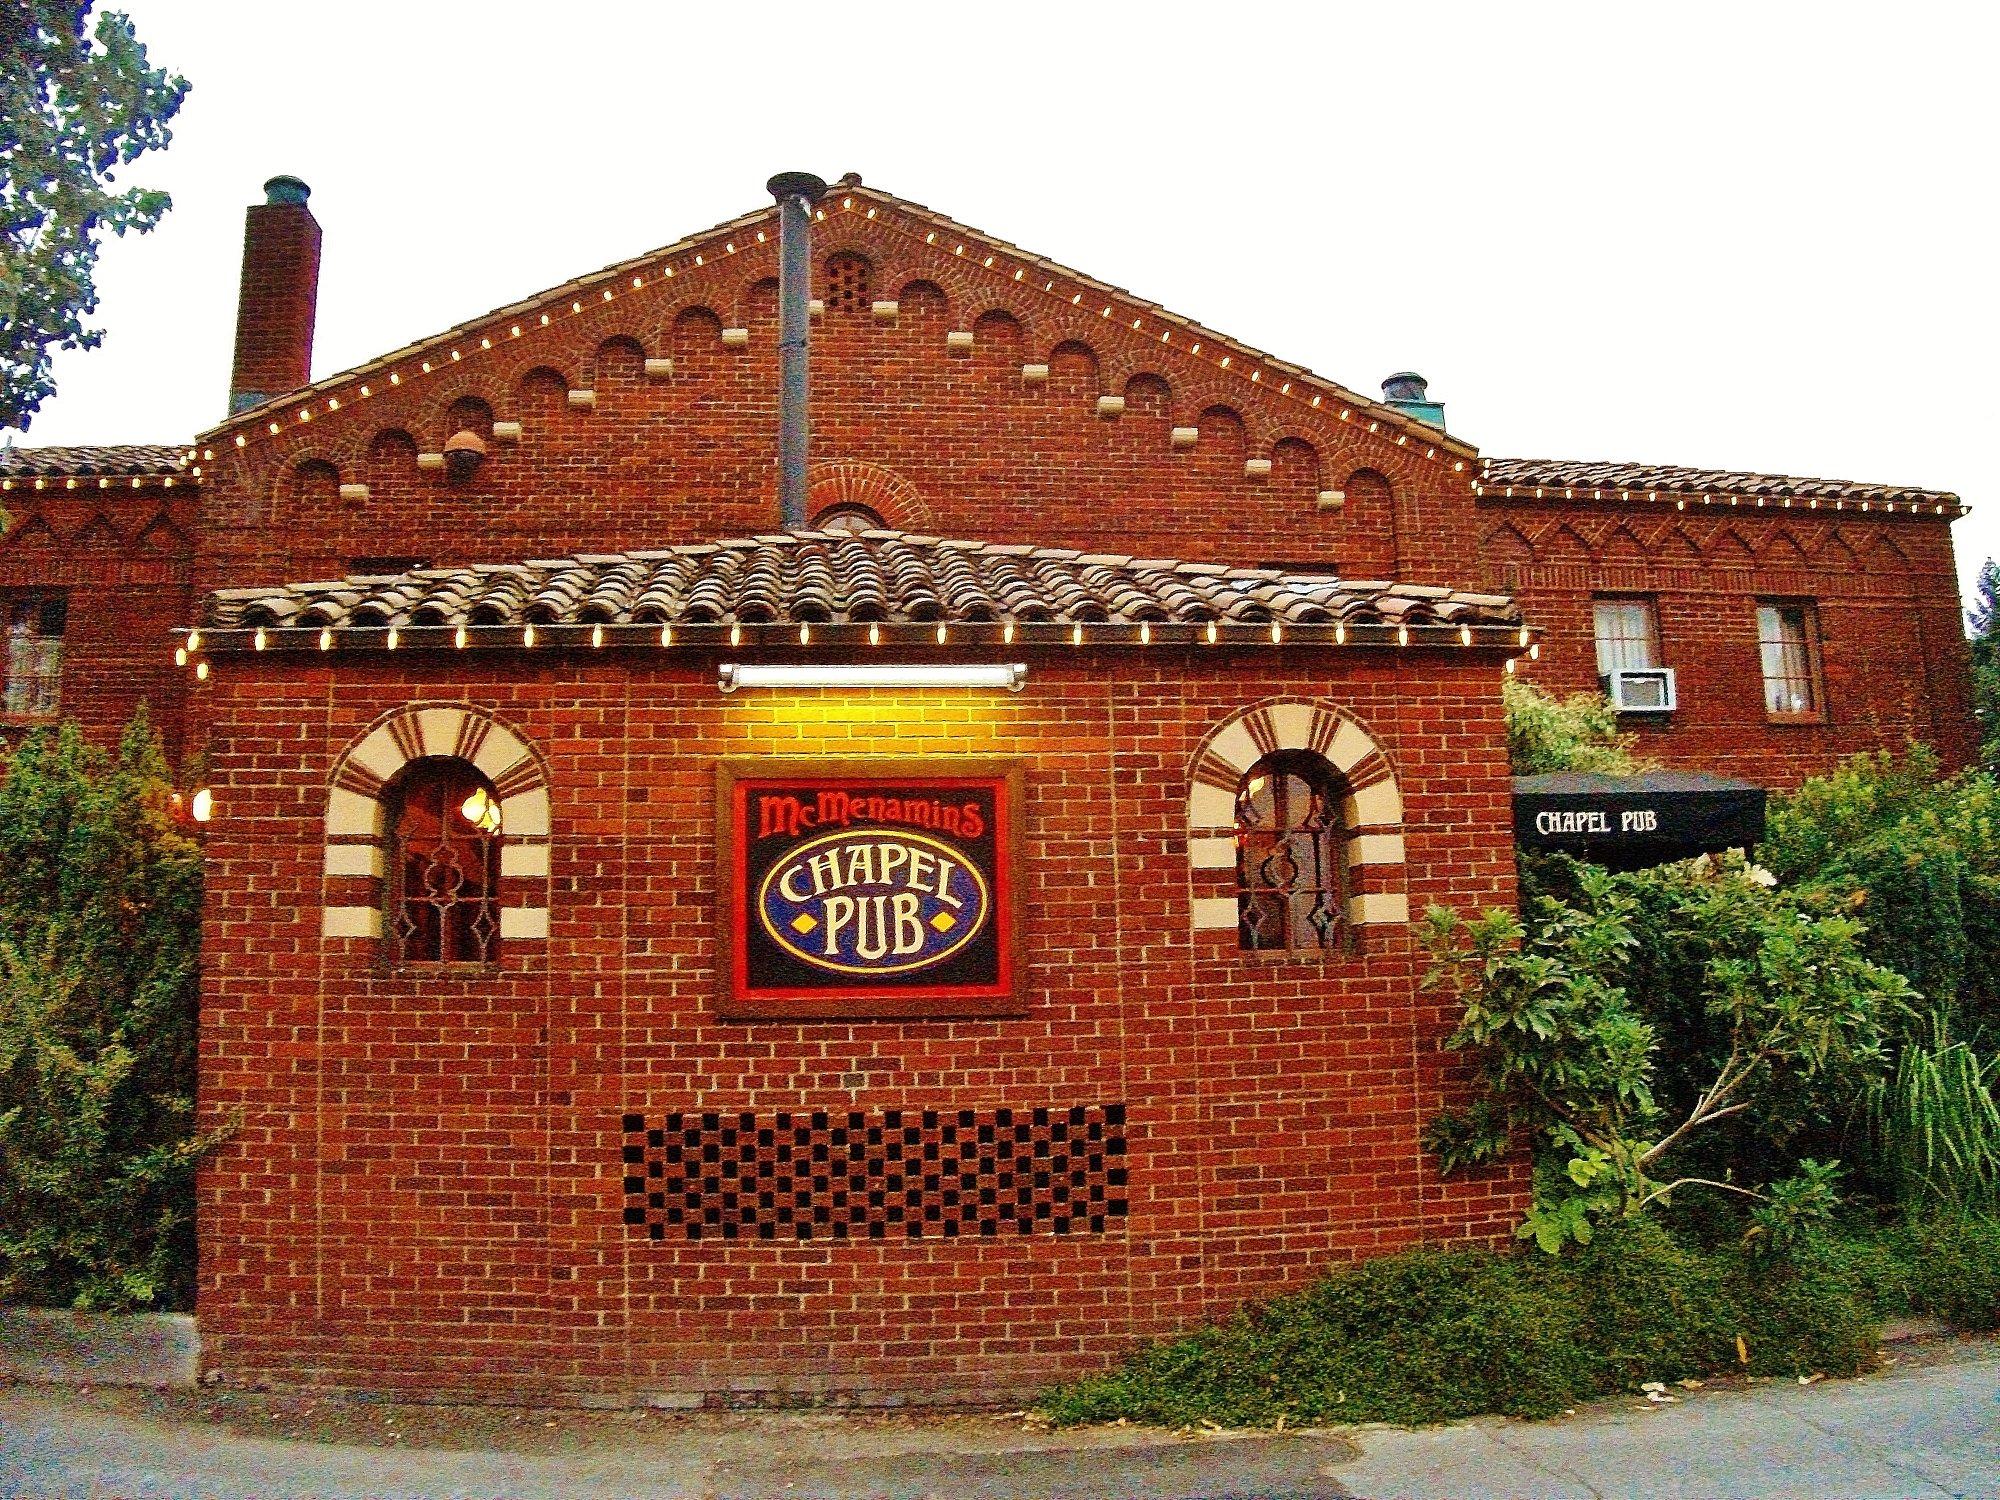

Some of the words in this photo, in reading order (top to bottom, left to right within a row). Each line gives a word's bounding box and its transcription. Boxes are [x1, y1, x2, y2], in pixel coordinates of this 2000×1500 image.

[758, 791, 985, 839] McMenamins
[1536, 811, 1611, 835] CHAPEL
[1621, 810, 1658, 832] PUB
[779, 843, 963, 909] CHAPEL
[823, 892, 925, 960] PUB
